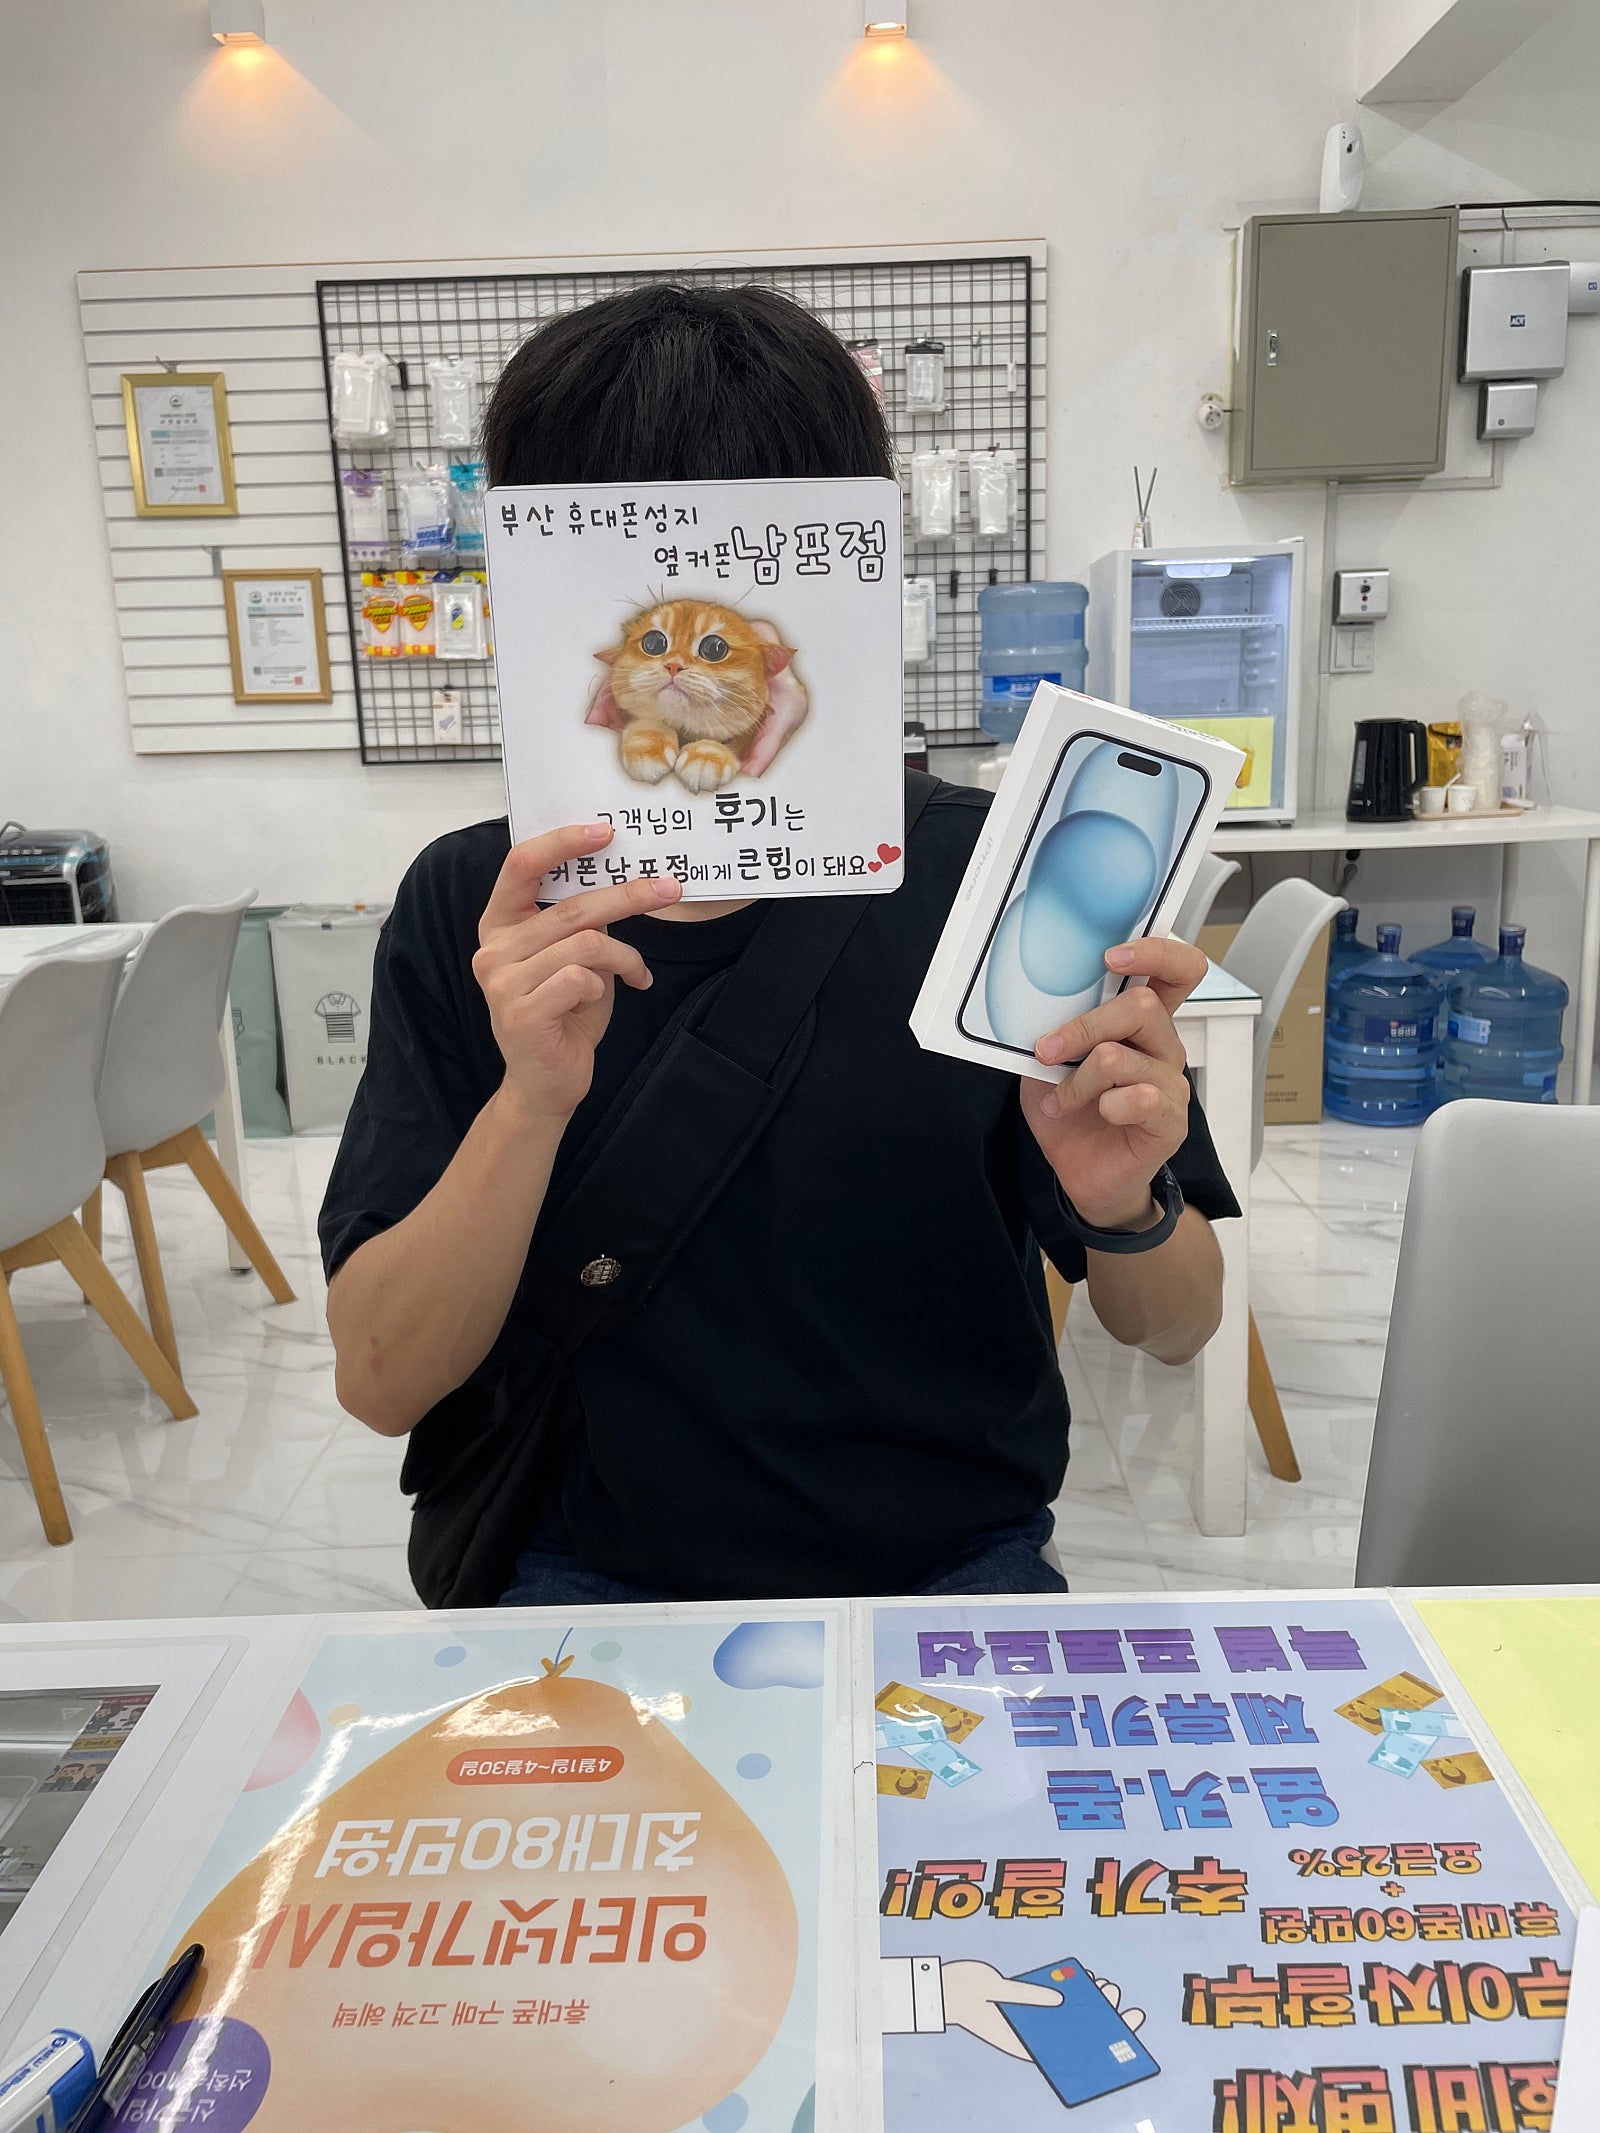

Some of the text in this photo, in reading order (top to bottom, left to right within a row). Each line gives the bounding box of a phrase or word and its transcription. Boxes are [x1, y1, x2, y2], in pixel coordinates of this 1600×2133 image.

[501, 504, 554, 536] 부산
[714, 792, 806, 834] 후기는
[823, 854, 868, 878] 돼요
[917, 1626, 1367, 1678] 특별 프로모션
[1003, 1692, 1319, 1747] 제휴카드
[460, 1757, 612, 1778] 4월1일~4월30일
[314, 1811, 701, 1879] 최대80만원
[1288, 1842, 1482, 1878] 요금25%
[880, 1855, 1248, 1920] 추가 할인!
[332, 2000, 590, 2028] 휴대폰 구매 고객 혜택
[1182, 1956, 1571, 2028] 무이자 할부!
[1213, 2066, 1395, 2132] 면제!
